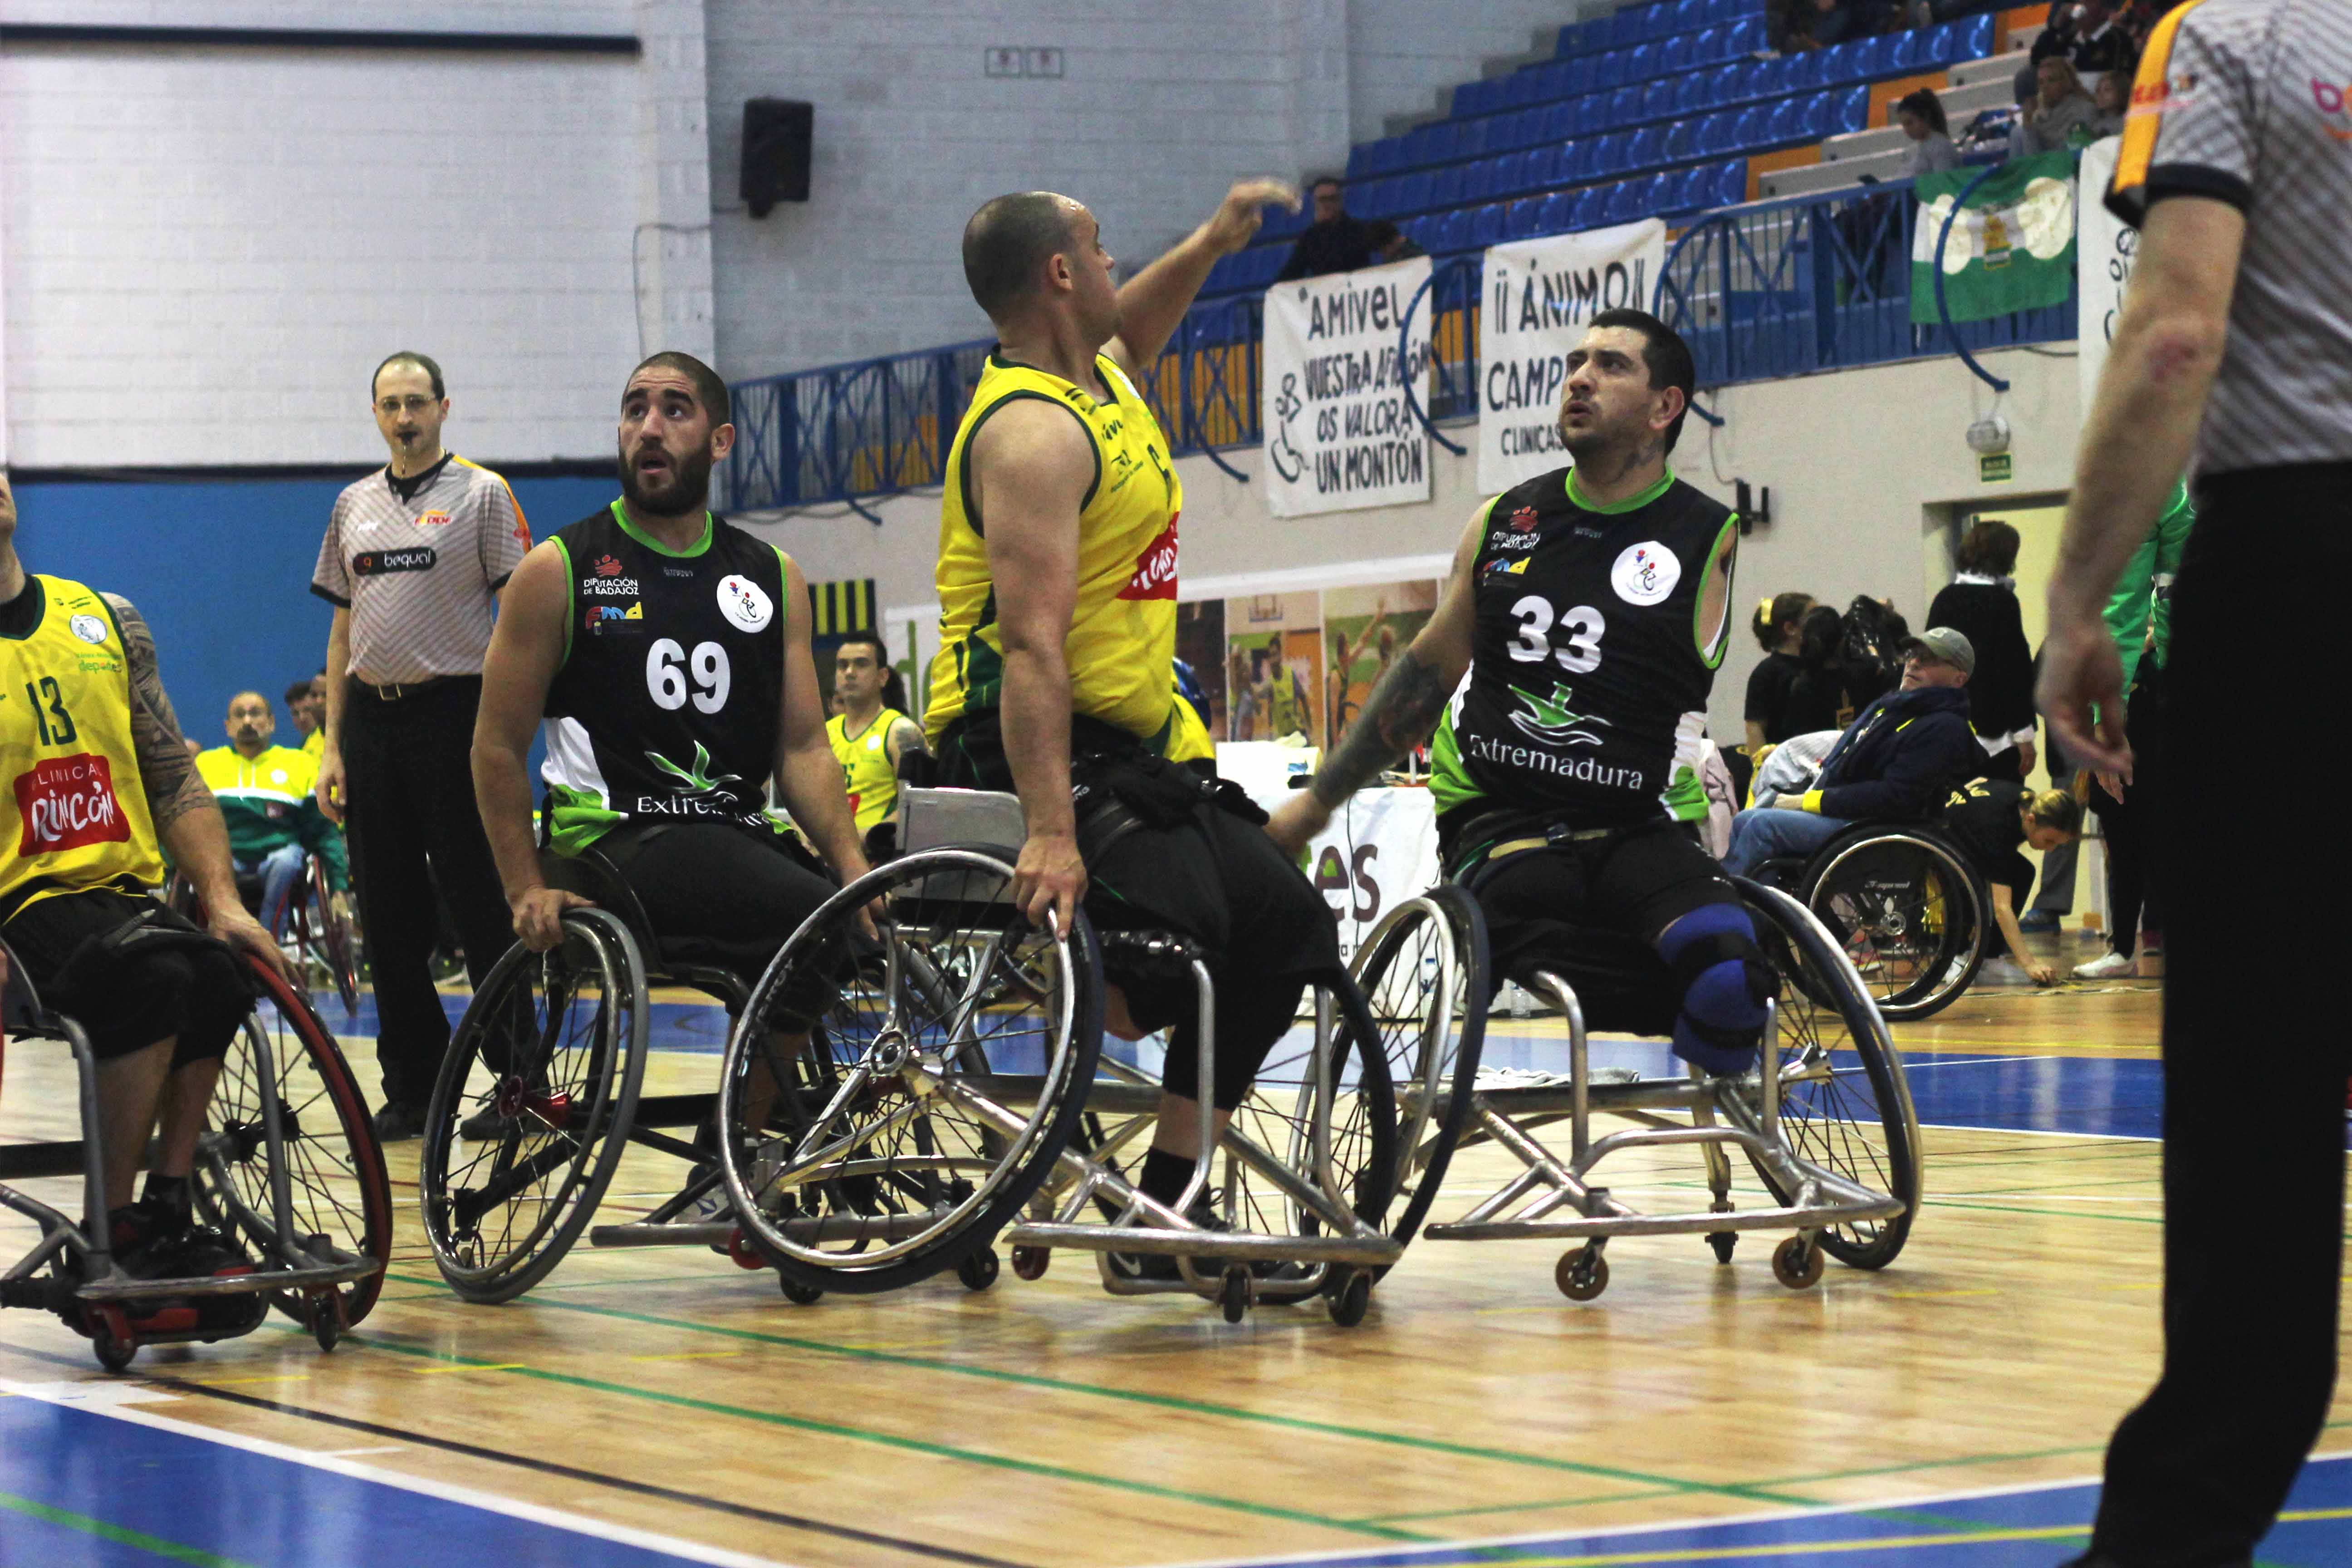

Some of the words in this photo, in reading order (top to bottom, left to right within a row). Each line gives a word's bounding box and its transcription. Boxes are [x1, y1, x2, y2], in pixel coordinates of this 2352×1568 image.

[1317, 407, 1338, 443] OS
[1316, 449, 1341, 494] UN
[1345, 431, 1422, 491] MONTÓN
[384, 550, 431, 568] bequal
[584, 576, 638, 588] DIPUTACIÓN
[595, 586, 639, 595] BADAJOZ
[1506, 595, 1606, 674] 33
[646, 638, 730, 715] 69
[25, 676, 77, 746] 13
[1470, 734, 1643, 790] Extremadura
